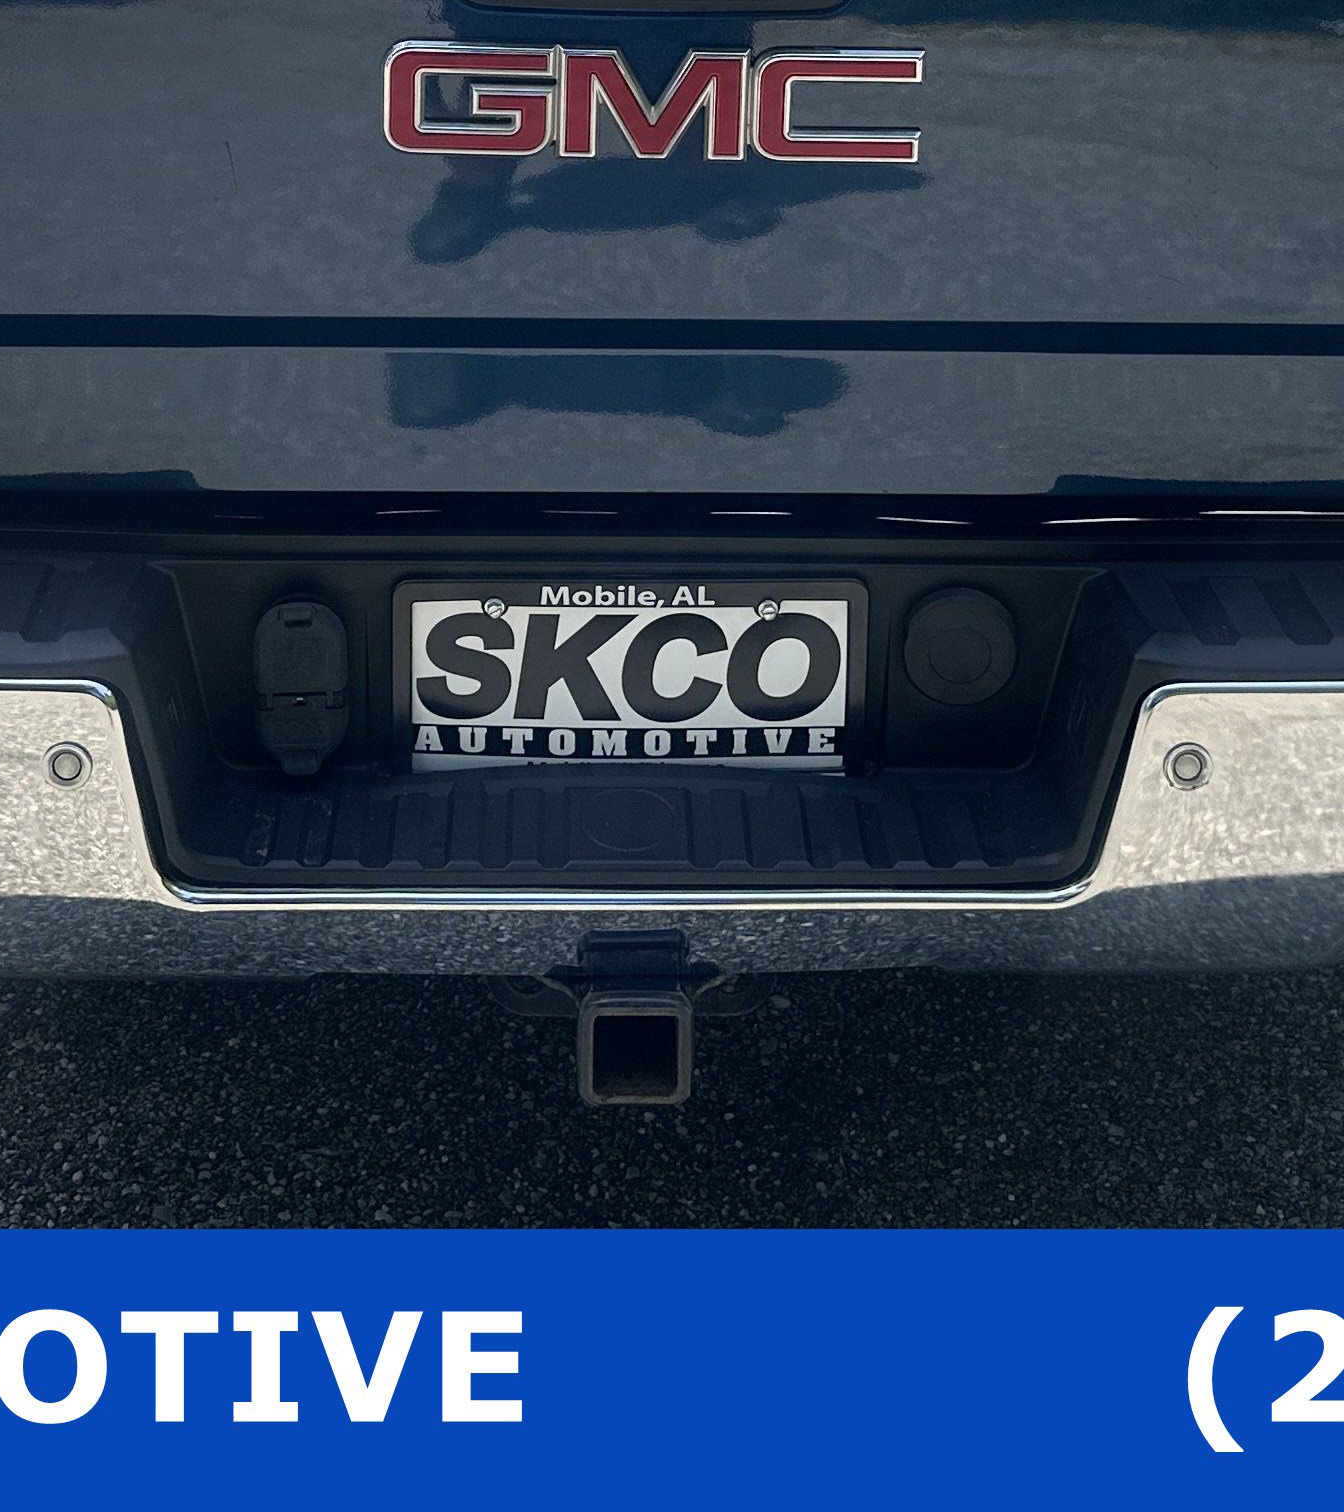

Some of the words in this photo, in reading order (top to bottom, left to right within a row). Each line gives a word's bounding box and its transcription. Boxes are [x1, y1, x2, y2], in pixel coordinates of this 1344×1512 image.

[383, 40, 925, 163] GMC
[540, 585, 666, 609] Mobile,
[672, 585, 716, 606] AL
[416, 612, 842, 723] SKCO
[414, 725, 836, 756] AUTOMOTIVE
